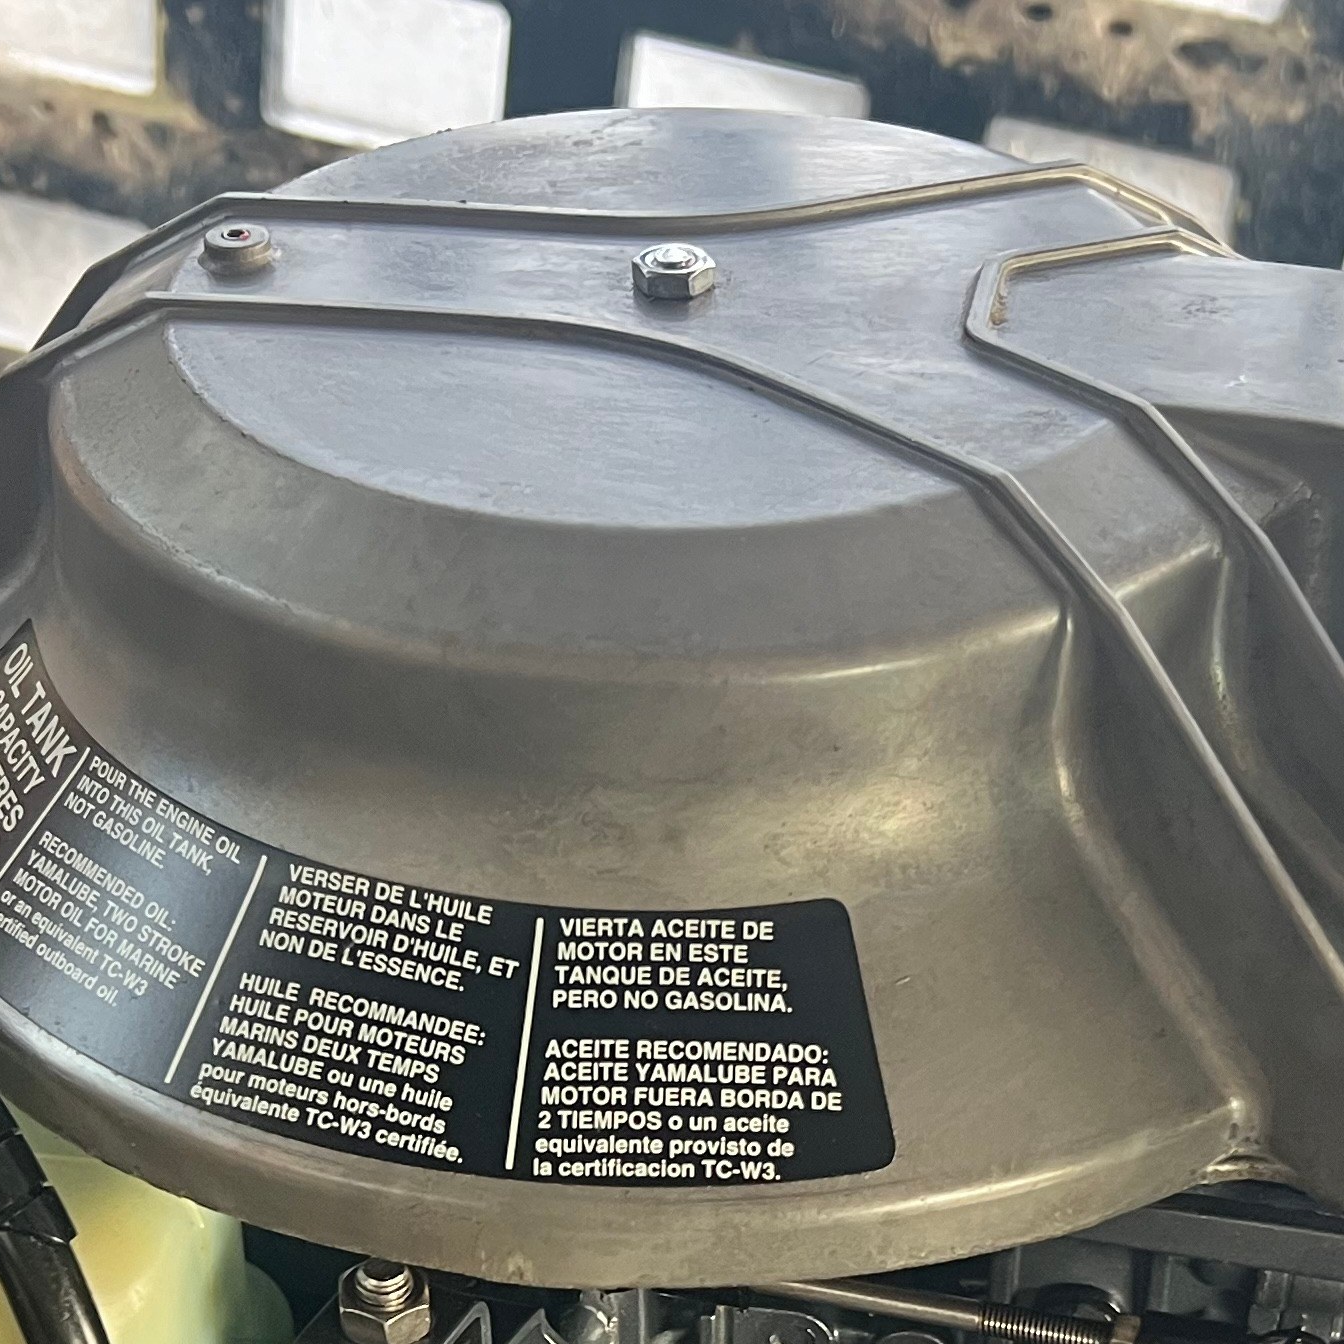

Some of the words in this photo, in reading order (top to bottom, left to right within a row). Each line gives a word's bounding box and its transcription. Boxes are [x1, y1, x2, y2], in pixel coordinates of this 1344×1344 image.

[4, 643, 33, 698] OIL
[21, 681, 77, 778] TANK
[64, 792, 96, 819] NOT
[77, 775, 110, 804] INTO
[110, 795, 142, 825] THIS
[142, 817, 165, 843] OIL
[169, 832, 213, 875] TANK,
[89, 756, 127, 790] POUR
[128, 779, 157, 808] THE
[156, 798, 215, 845] ENGINE
[216, 836, 240, 864] OIL
[39, 831, 144, 909] RECOMMENDED
[145, 902, 176, 931] OIL:
[290, 864, 370, 897] VERSER
[375, 882, 404, 904] DE
[409, 890, 493, 925] L'HUILE
[1, 890, 17, 905] or
[14, 900, 32, 918] an
[31, 912, 99, 964] equivalent
[100, 954, 148, 996] TC-W3
[13, 868, 62, 910] MOTOR
[61, 901, 83, 927] OIL
[84, 917, 118, 948] FOR
[116, 939, 180, 989] MARINE
[27, 849, 100, 912] YAMALUBE,
[103, 900, 138, 932] TWO
[138, 925, 205, 977] STROKE
[269, 907, 388, 949] RESERVOIR
[393, 934, 481, 974] D'HUILE,
[488, 956, 520, 978] ET
[279, 886, 366, 920] MOTEUR
[370, 905, 431, 934] DANS
[435, 919, 464, 942] LE
[560, 918, 644, 937] VIERTA
[651, 919, 735, 939] ACEITE
[743, 921, 773, 940] DE
[36, 943, 98, 990] outboard
[96, 985, 118, 1006] oil.
[259, 929, 305, 954] NON
[308, 939, 338, 961] DE
[341, 947, 464, 991] L'ESSENCE.
[554, 965, 652, 985] TANQUE
[659, 967, 690, 986] DE
[697, 967, 787, 992] ACEITE,
[558, 941, 643, 961] MOTOR
[650, 943, 681, 961] EN
[689, 943, 748, 963] ESTE
[229, 994, 291, 1023] HUILE
[293, 1009, 354, 1038] POUR
[358, 1023, 465, 1064] MOTEURS
[239, 973, 300, 1001] HUILE
[309, 988, 485, 1046] RECOMMANDEE:
[553, 989, 617, 1009] PERO
[624, 990, 658, 1009] NO
[665, 991, 792, 1013] GASOLINA.
[213, 1037, 324, 1080] YAMALUBE
[327, 1069, 354, 1087] ou
[359, 1076, 397, 1097] une
[401, 1083, 453, 1111] huile
[219, 1016, 299, 1049] MARINS
[302, 1035, 362, 1064] DEUX
[367, 1049, 440, 1083] TEMPS
[544, 1061, 628, 1081] ACEITE
[635, 1063, 766, 1084] YAMALUBE
[773, 1066, 837, 1087] PARA
[545, 1039, 629, 1059] ACEITE
[637, 1040, 828, 1064] RECOMENDADO:
[191, 1081, 299, 1122] équivalente
[306, 1107, 372, 1139] TC-W3
[375, 1129, 463, 1163] certifiée.
[198, 1063, 245, 1084] pour
[248, 1074, 328, 1105] moteurs
[333, 1091, 446, 1134] hors-bords
[538, 1111, 551, 1129] 2
[557, 1110, 662, 1130] TIEMPOS
[668, 1115, 683, 1130] o
[689, 1116, 717, 1131] un
[723, 1113, 789, 1133] aceite
[541, 1085, 627, 1105] MOTOR
[634, 1087, 713, 1107] FUERA
[721, 1089, 804, 1109] BORDA
[811, 1091, 842, 1111] DE
[533, 1157, 552, 1176] la
[558, 1158, 695, 1178] certificacion
[701, 1159, 781, 1180] TC-W3.
[535, 1134, 663, 1157] equivalente
[669, 1136, 761, 1159] provisto
[767, 1138, 794, 1157] de
